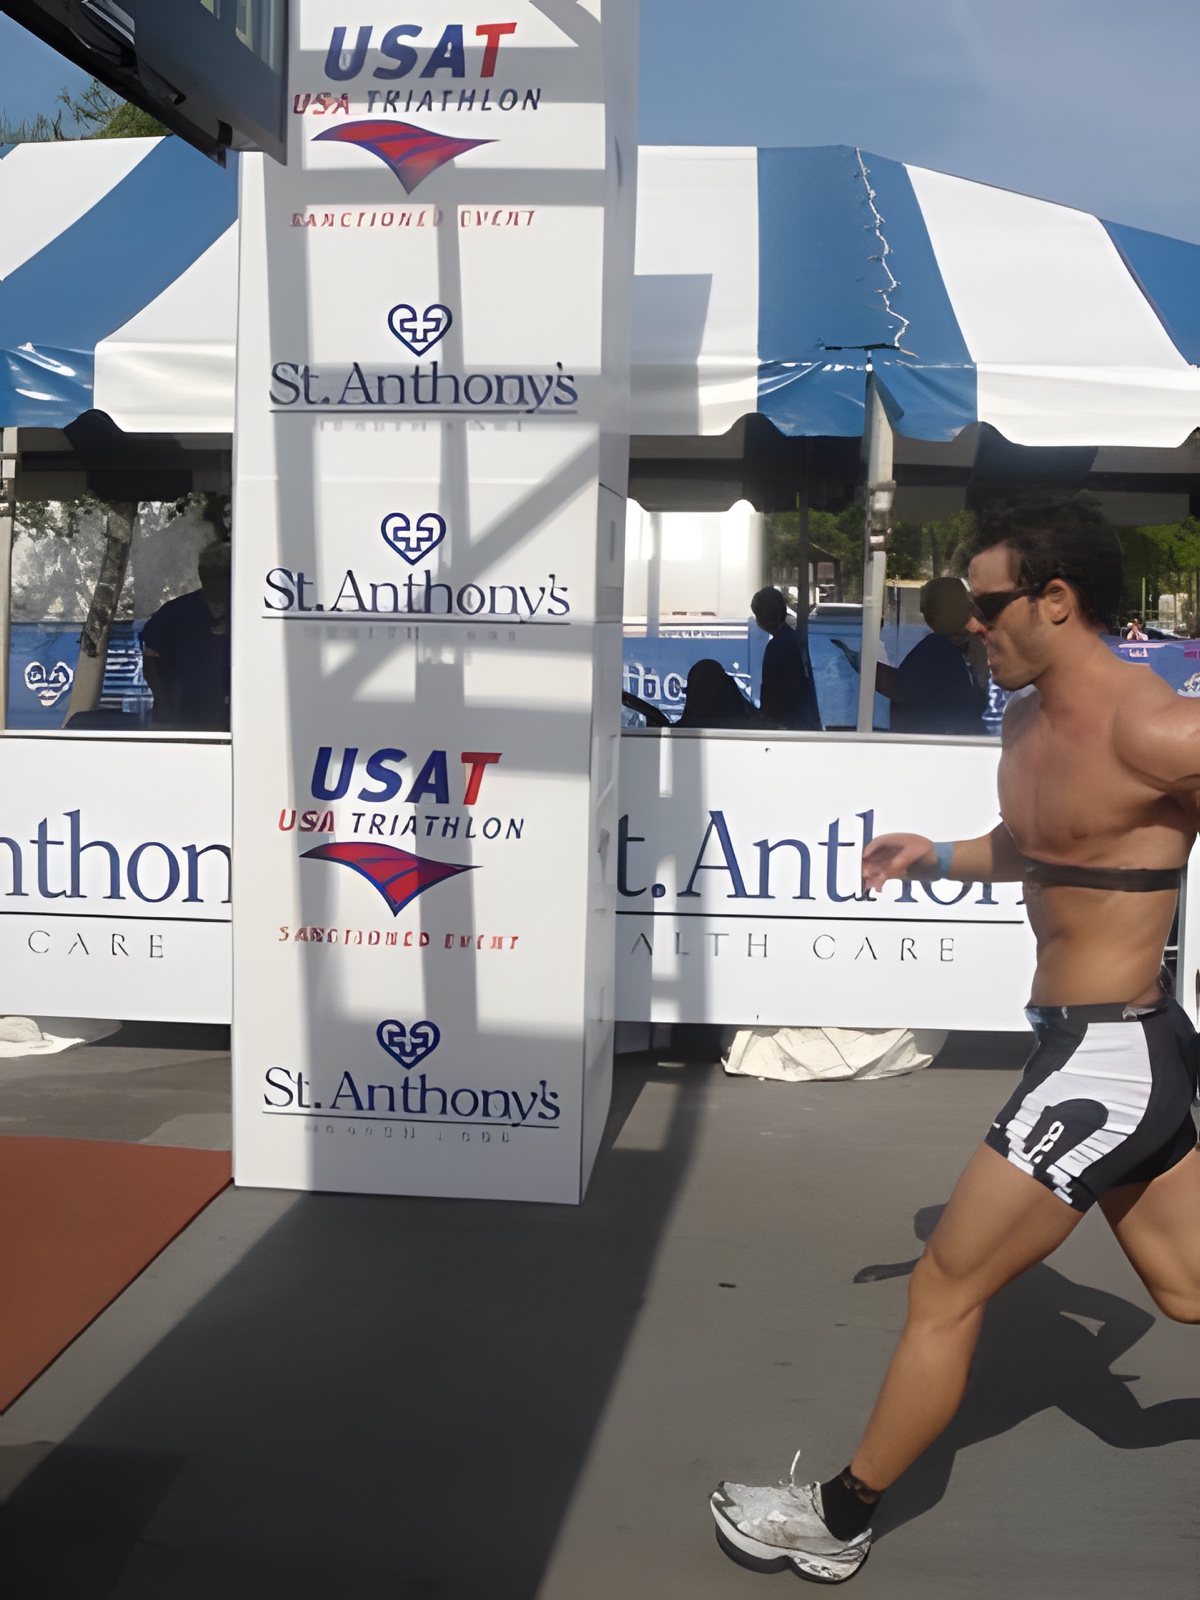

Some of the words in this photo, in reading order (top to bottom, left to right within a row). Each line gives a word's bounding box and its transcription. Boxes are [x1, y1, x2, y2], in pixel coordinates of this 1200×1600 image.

[323, 22, 517, 81] USAT
[293, 93, 349, 115] USA
[367, 88, 541, 114] TRIATHLON
[337, 360, 579, 413] Anthony's
[329, 569, 571, 622] Anthony's
[311, 746, 502, 805] USAT
[278, 808, 335, 833] USA
[351, 812, 524, 840] TRIATHLON
[27, 929, 164, 959] CARE
[812, 934, 955, 962] CARE
[263, 1066, 322, 1109] St.
[330, 1070, 561, 1127] Anthony's
